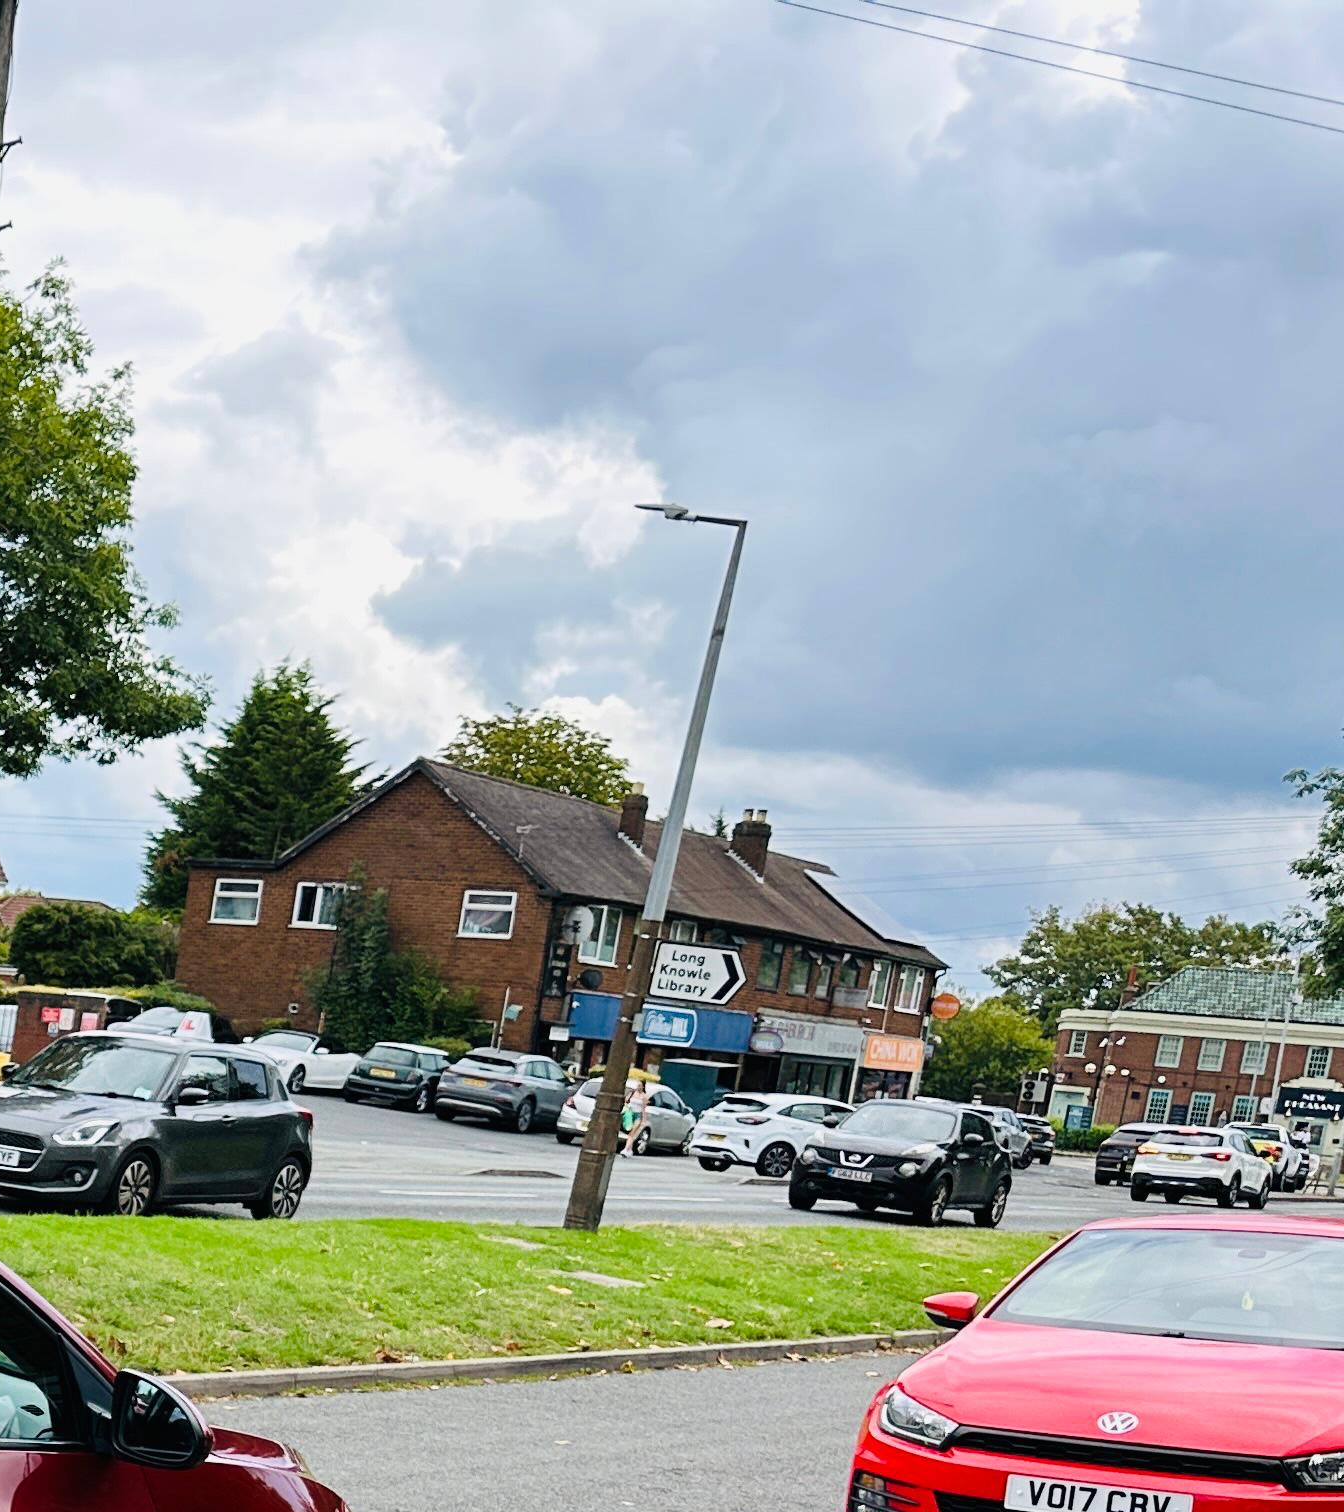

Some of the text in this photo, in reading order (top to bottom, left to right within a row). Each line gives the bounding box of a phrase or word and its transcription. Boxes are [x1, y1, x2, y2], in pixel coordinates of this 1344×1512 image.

[672, 950, 706, 966] Long
[660, 963, 711, 980] Knowle
[657, 978, 707, 997] Library
